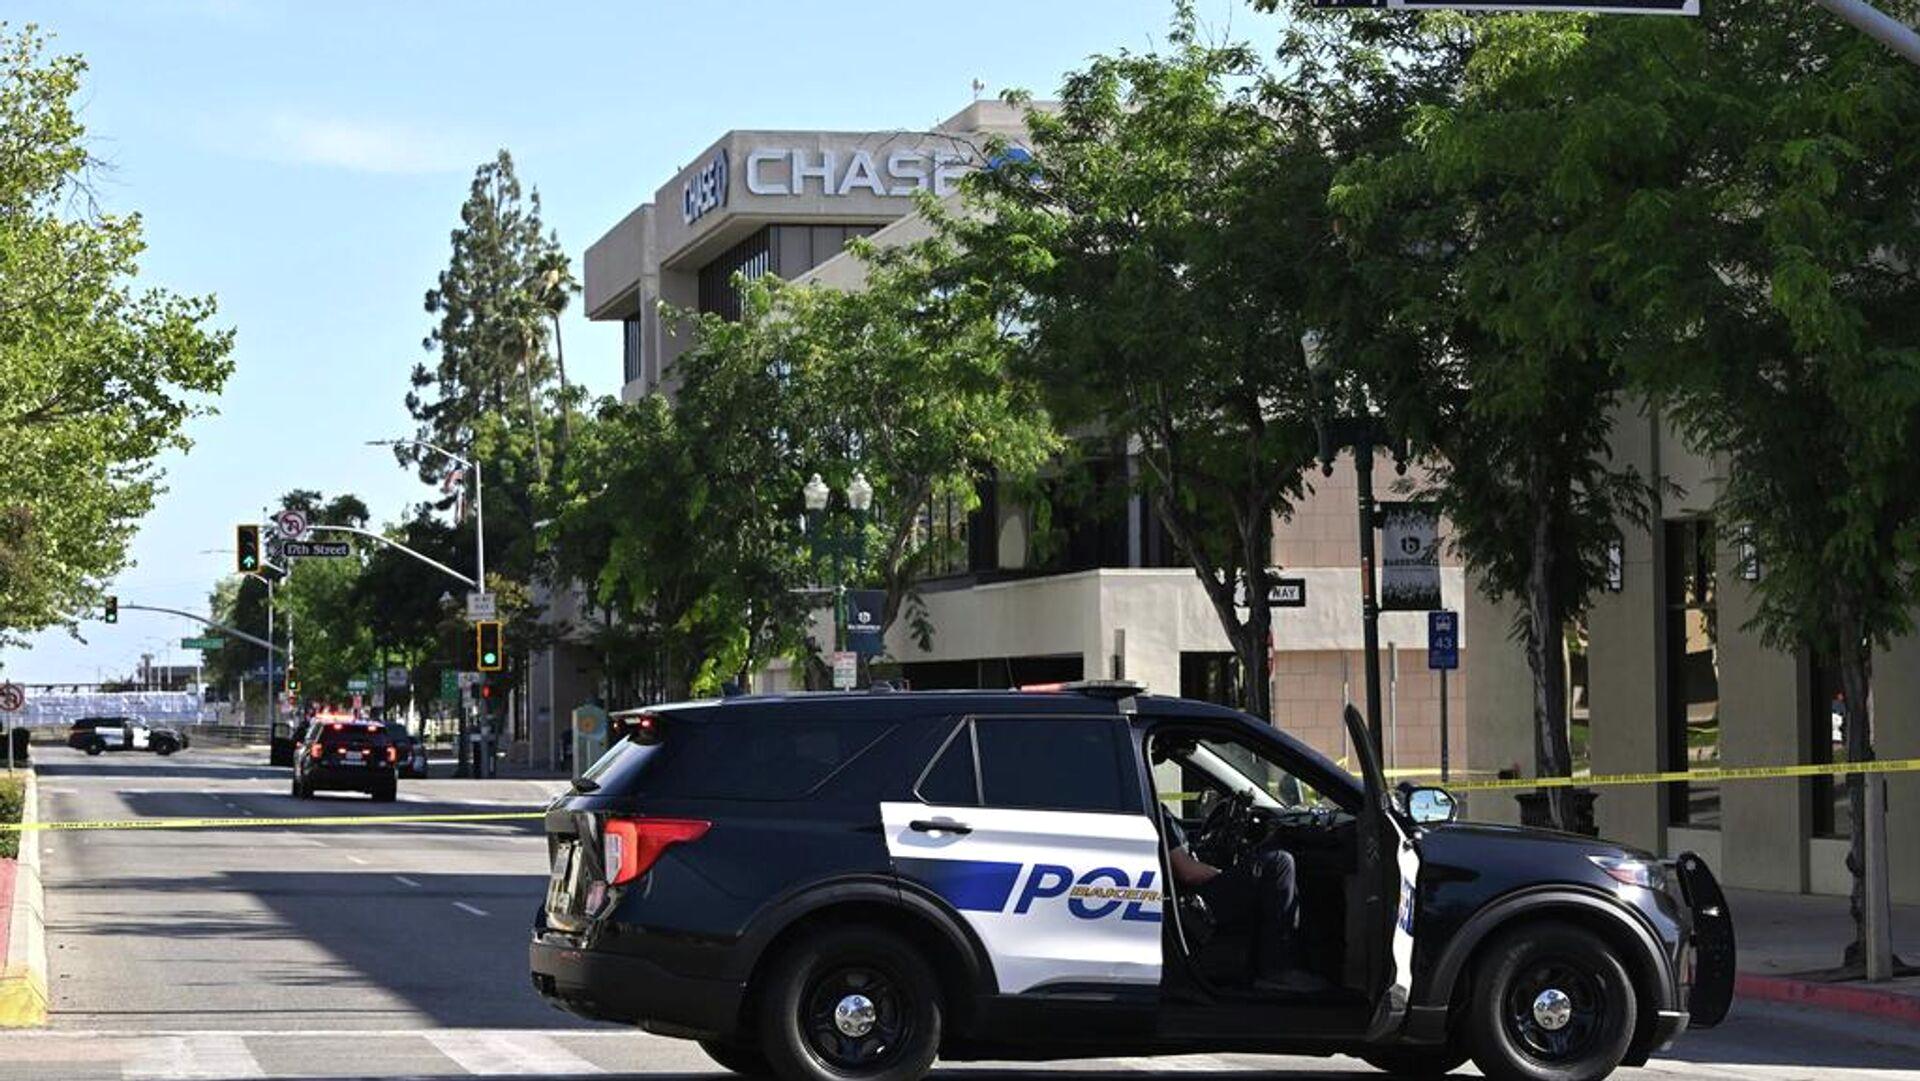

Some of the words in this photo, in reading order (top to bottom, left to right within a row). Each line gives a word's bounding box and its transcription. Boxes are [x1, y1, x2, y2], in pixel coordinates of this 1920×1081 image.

[683, 158, 717, 224] CHASE
[746, 148, 972, 197] CHASE
[287, 544, 310, 555] 17th
[313, 544, 347, 555] Street
[1434, 637, 1453, 649] 43
[1014, 863, 1163, 922] POL
